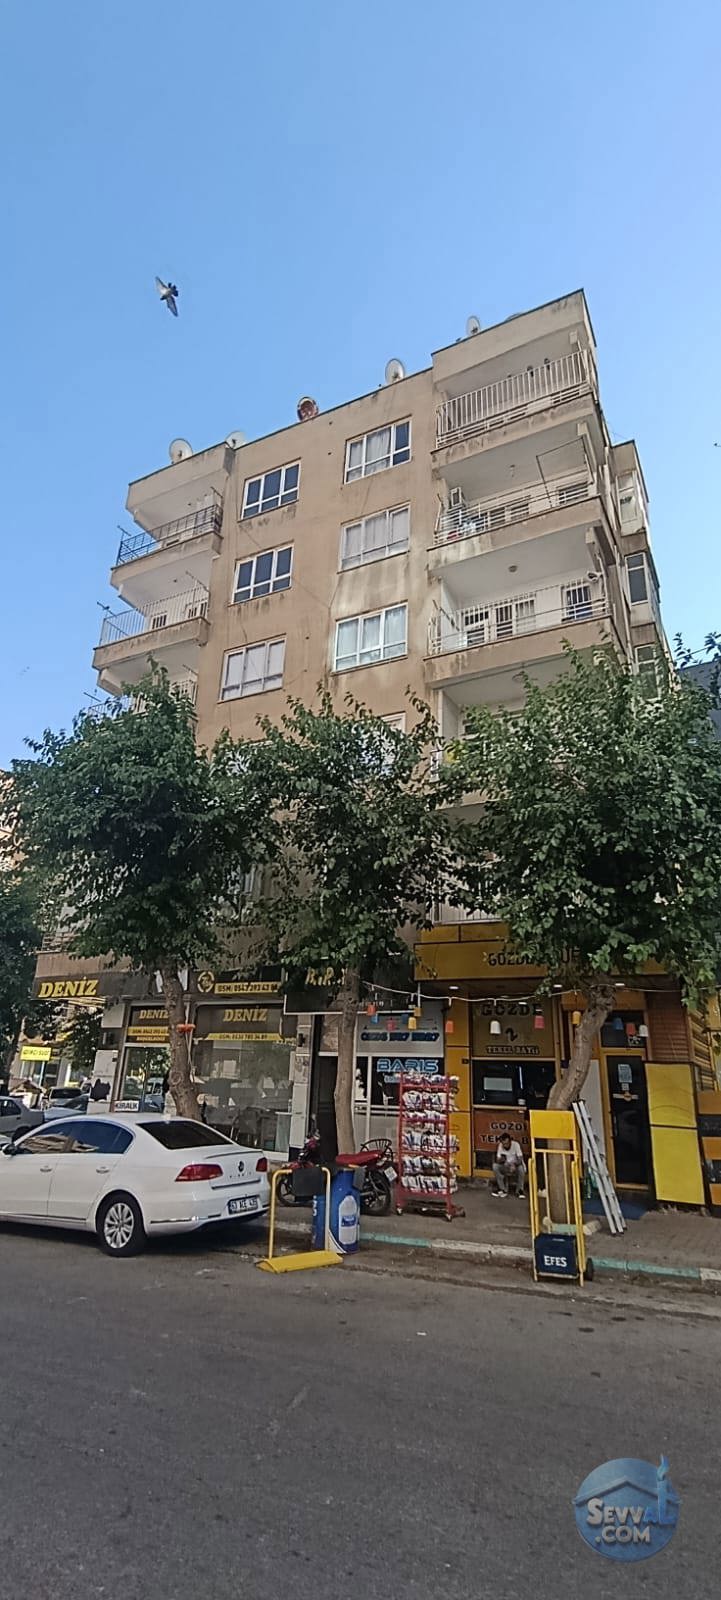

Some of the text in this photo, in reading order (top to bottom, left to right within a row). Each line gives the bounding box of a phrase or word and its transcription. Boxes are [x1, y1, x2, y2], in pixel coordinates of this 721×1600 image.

[38, 976, 98, 998] DENİZ
[223, 1005, 268, 1022] DENİZ
[543, 1255, 568, 1268] EFES
